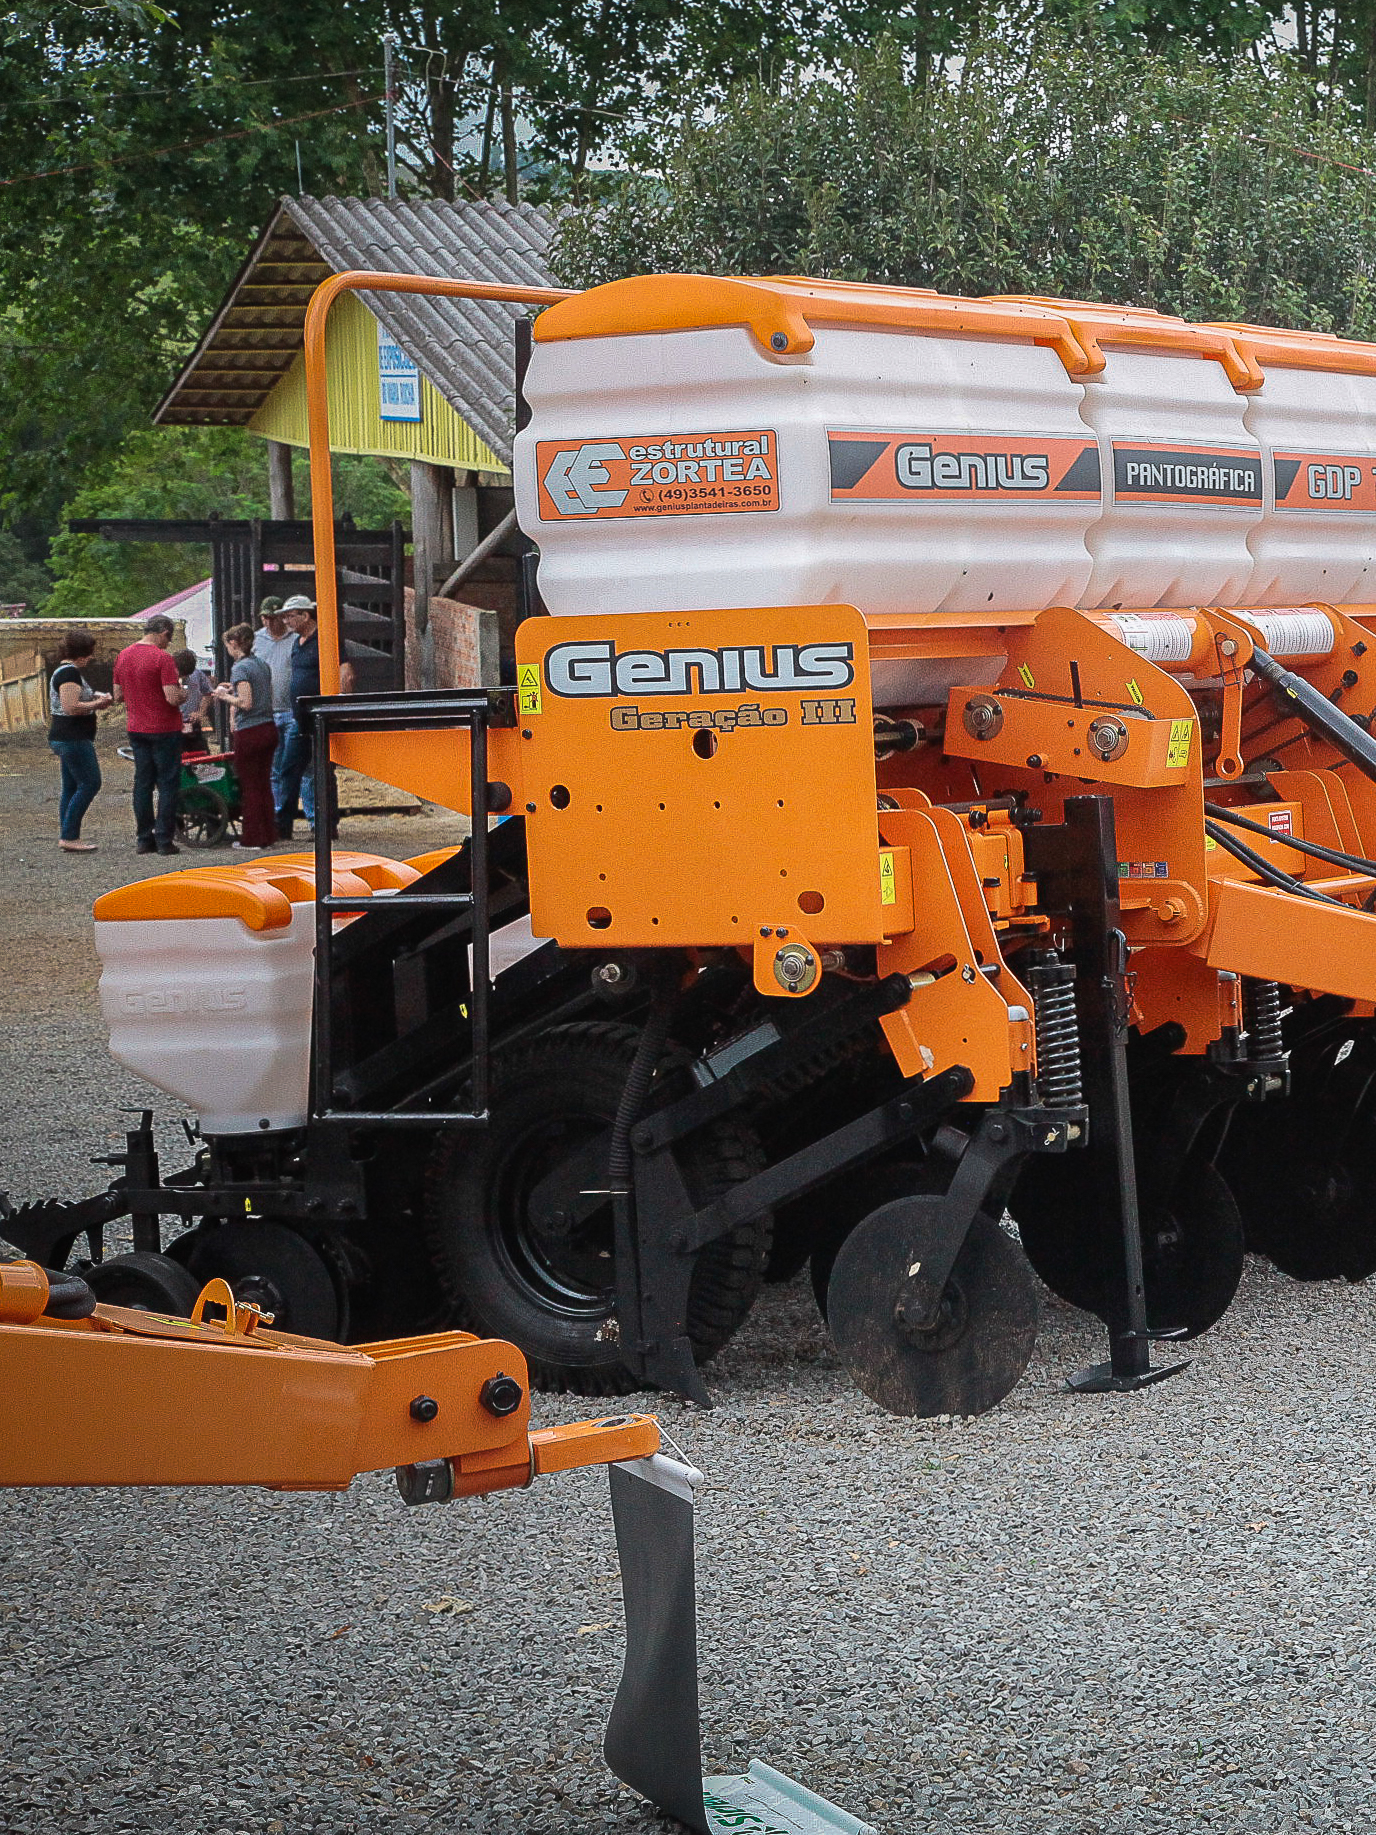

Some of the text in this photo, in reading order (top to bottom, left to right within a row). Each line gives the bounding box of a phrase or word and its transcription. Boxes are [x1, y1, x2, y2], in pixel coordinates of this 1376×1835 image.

[629, 435, 769, 461] estrutural
[630, 457, 772, 486] ZORTEA
[896, 443, 1049, 490] Genius
[1126, 462, 1256, 492] PANTOGRÁFICA
[659, 485, 771, 500] (49)3541-3650
[1307, 464, 1362, 500] GDP
[633, 499, 772, 513] www.geniusplantadeiras.com.br
[545, 641, 855, 697] Genius
[610, 703, 788, 733] Geração
